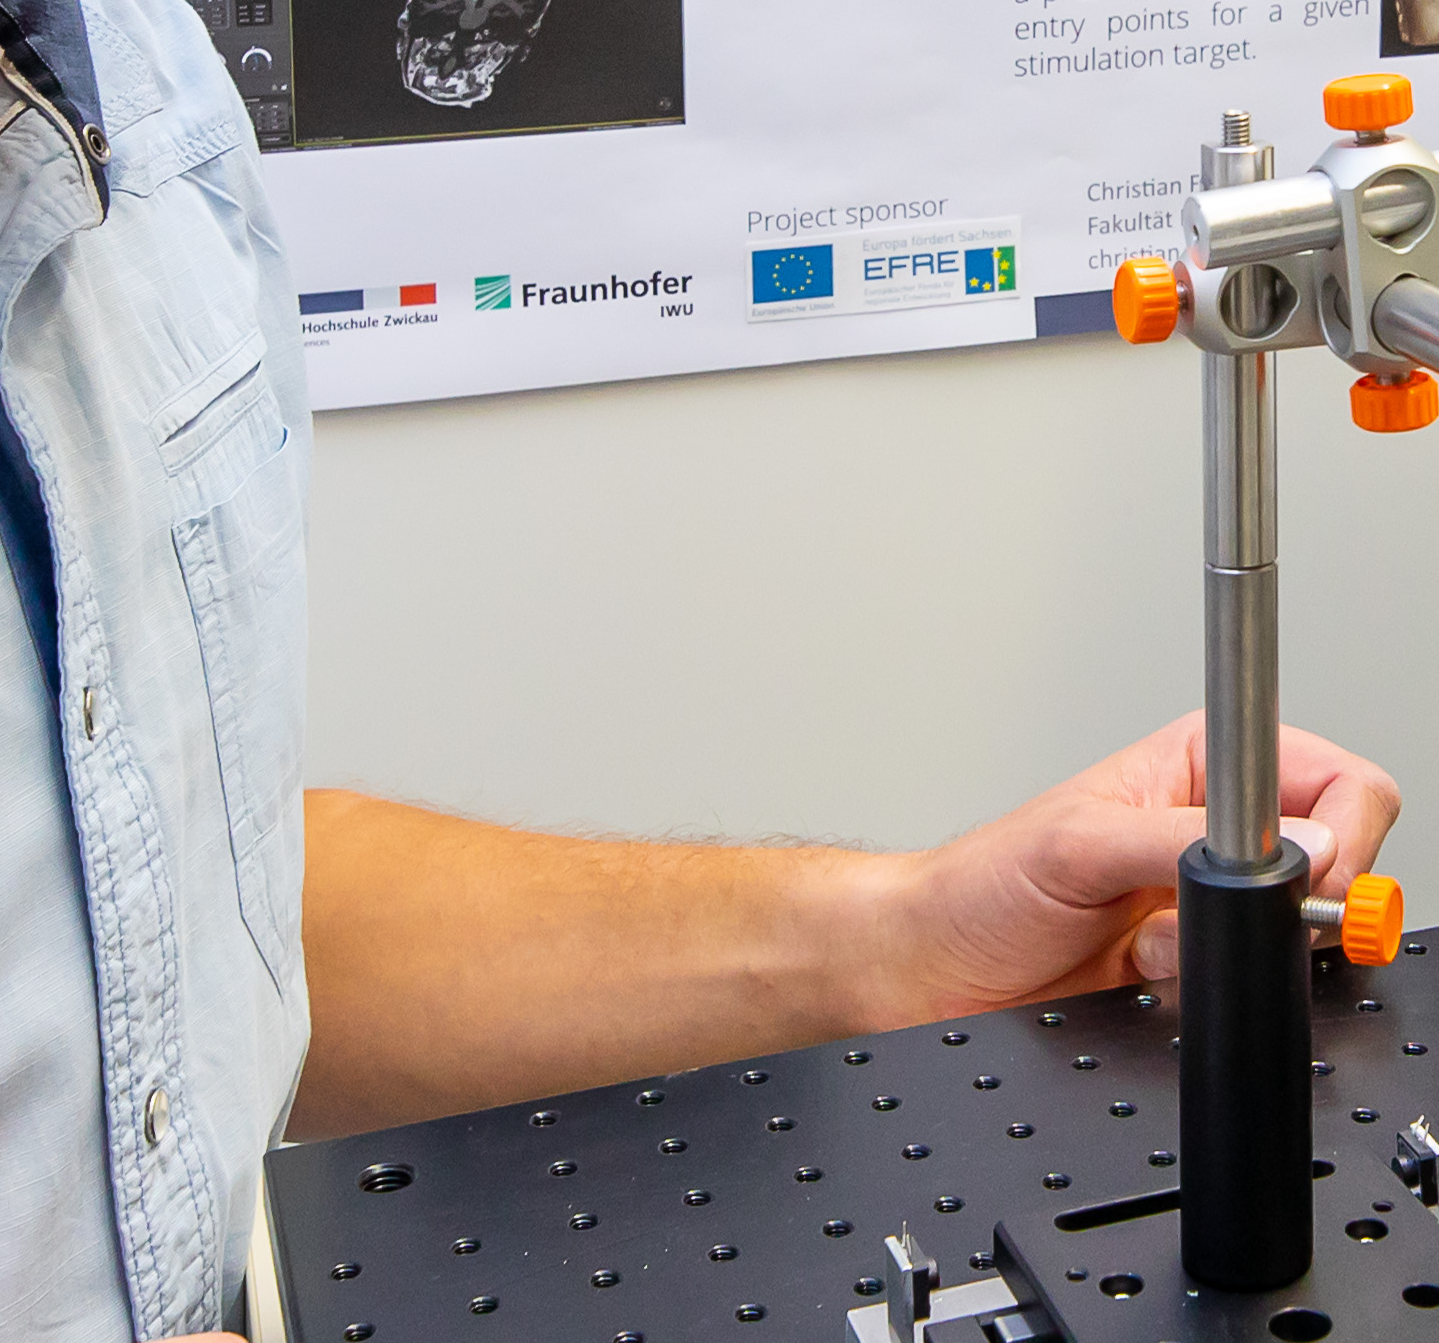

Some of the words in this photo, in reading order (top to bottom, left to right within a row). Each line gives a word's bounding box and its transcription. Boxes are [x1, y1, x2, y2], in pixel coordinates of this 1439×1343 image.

[1087, 177, 1182, 203] Christian
[747, 206, 838, 237] Project
[845, 196, 950, 228] sponsor
[1088, 211, 1174, 236] Fakultät
[522, 270, 693, 308] Fraunhofer
[301, 315, 380, 335] Hochschule
[384, 310, 439, 328] Zwickau
[660, 302, 694, 318] IWU
